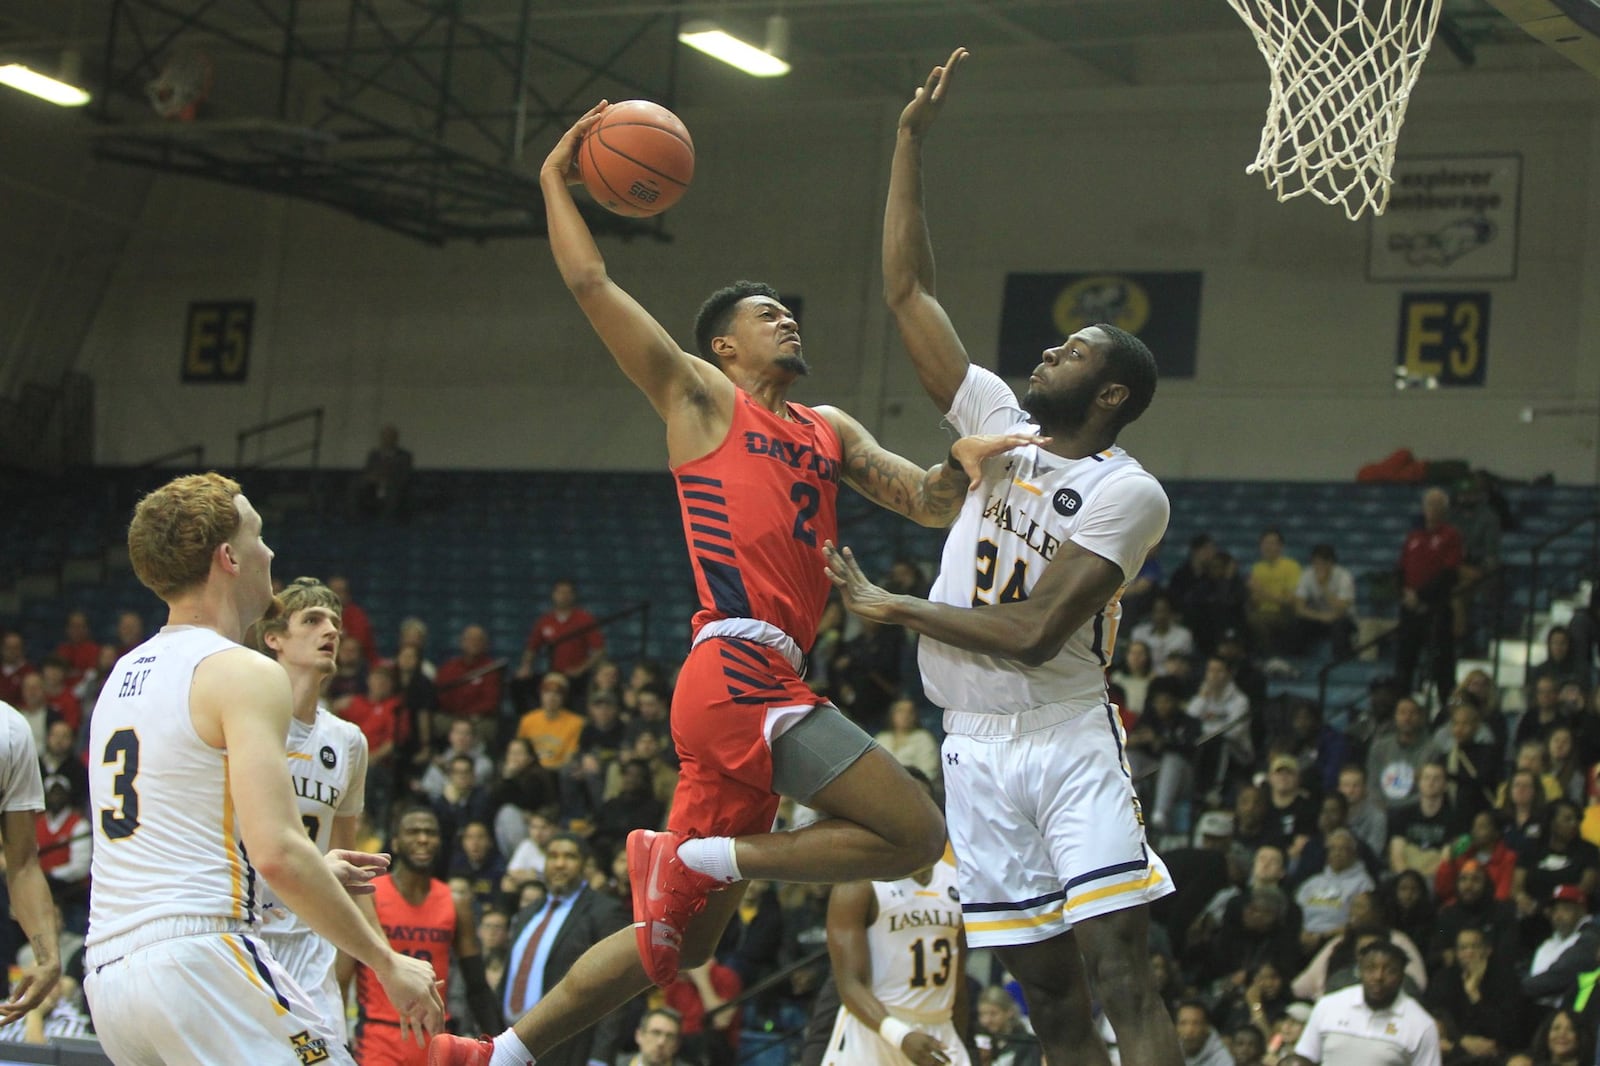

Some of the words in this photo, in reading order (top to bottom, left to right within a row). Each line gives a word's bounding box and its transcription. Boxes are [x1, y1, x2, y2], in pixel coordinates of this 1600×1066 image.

[187, 310, 247, 375] E5
[1405, 302, 1481, 378] E3
[790, 482, 821, 549] 2
[1058, 493, 1077, 510] RB
[971, 538, 1029, 607] 24
[100, 726, 141, 843] 3
[323, 751, 335, 763] RB
[910, 938, 952, 989] 13
